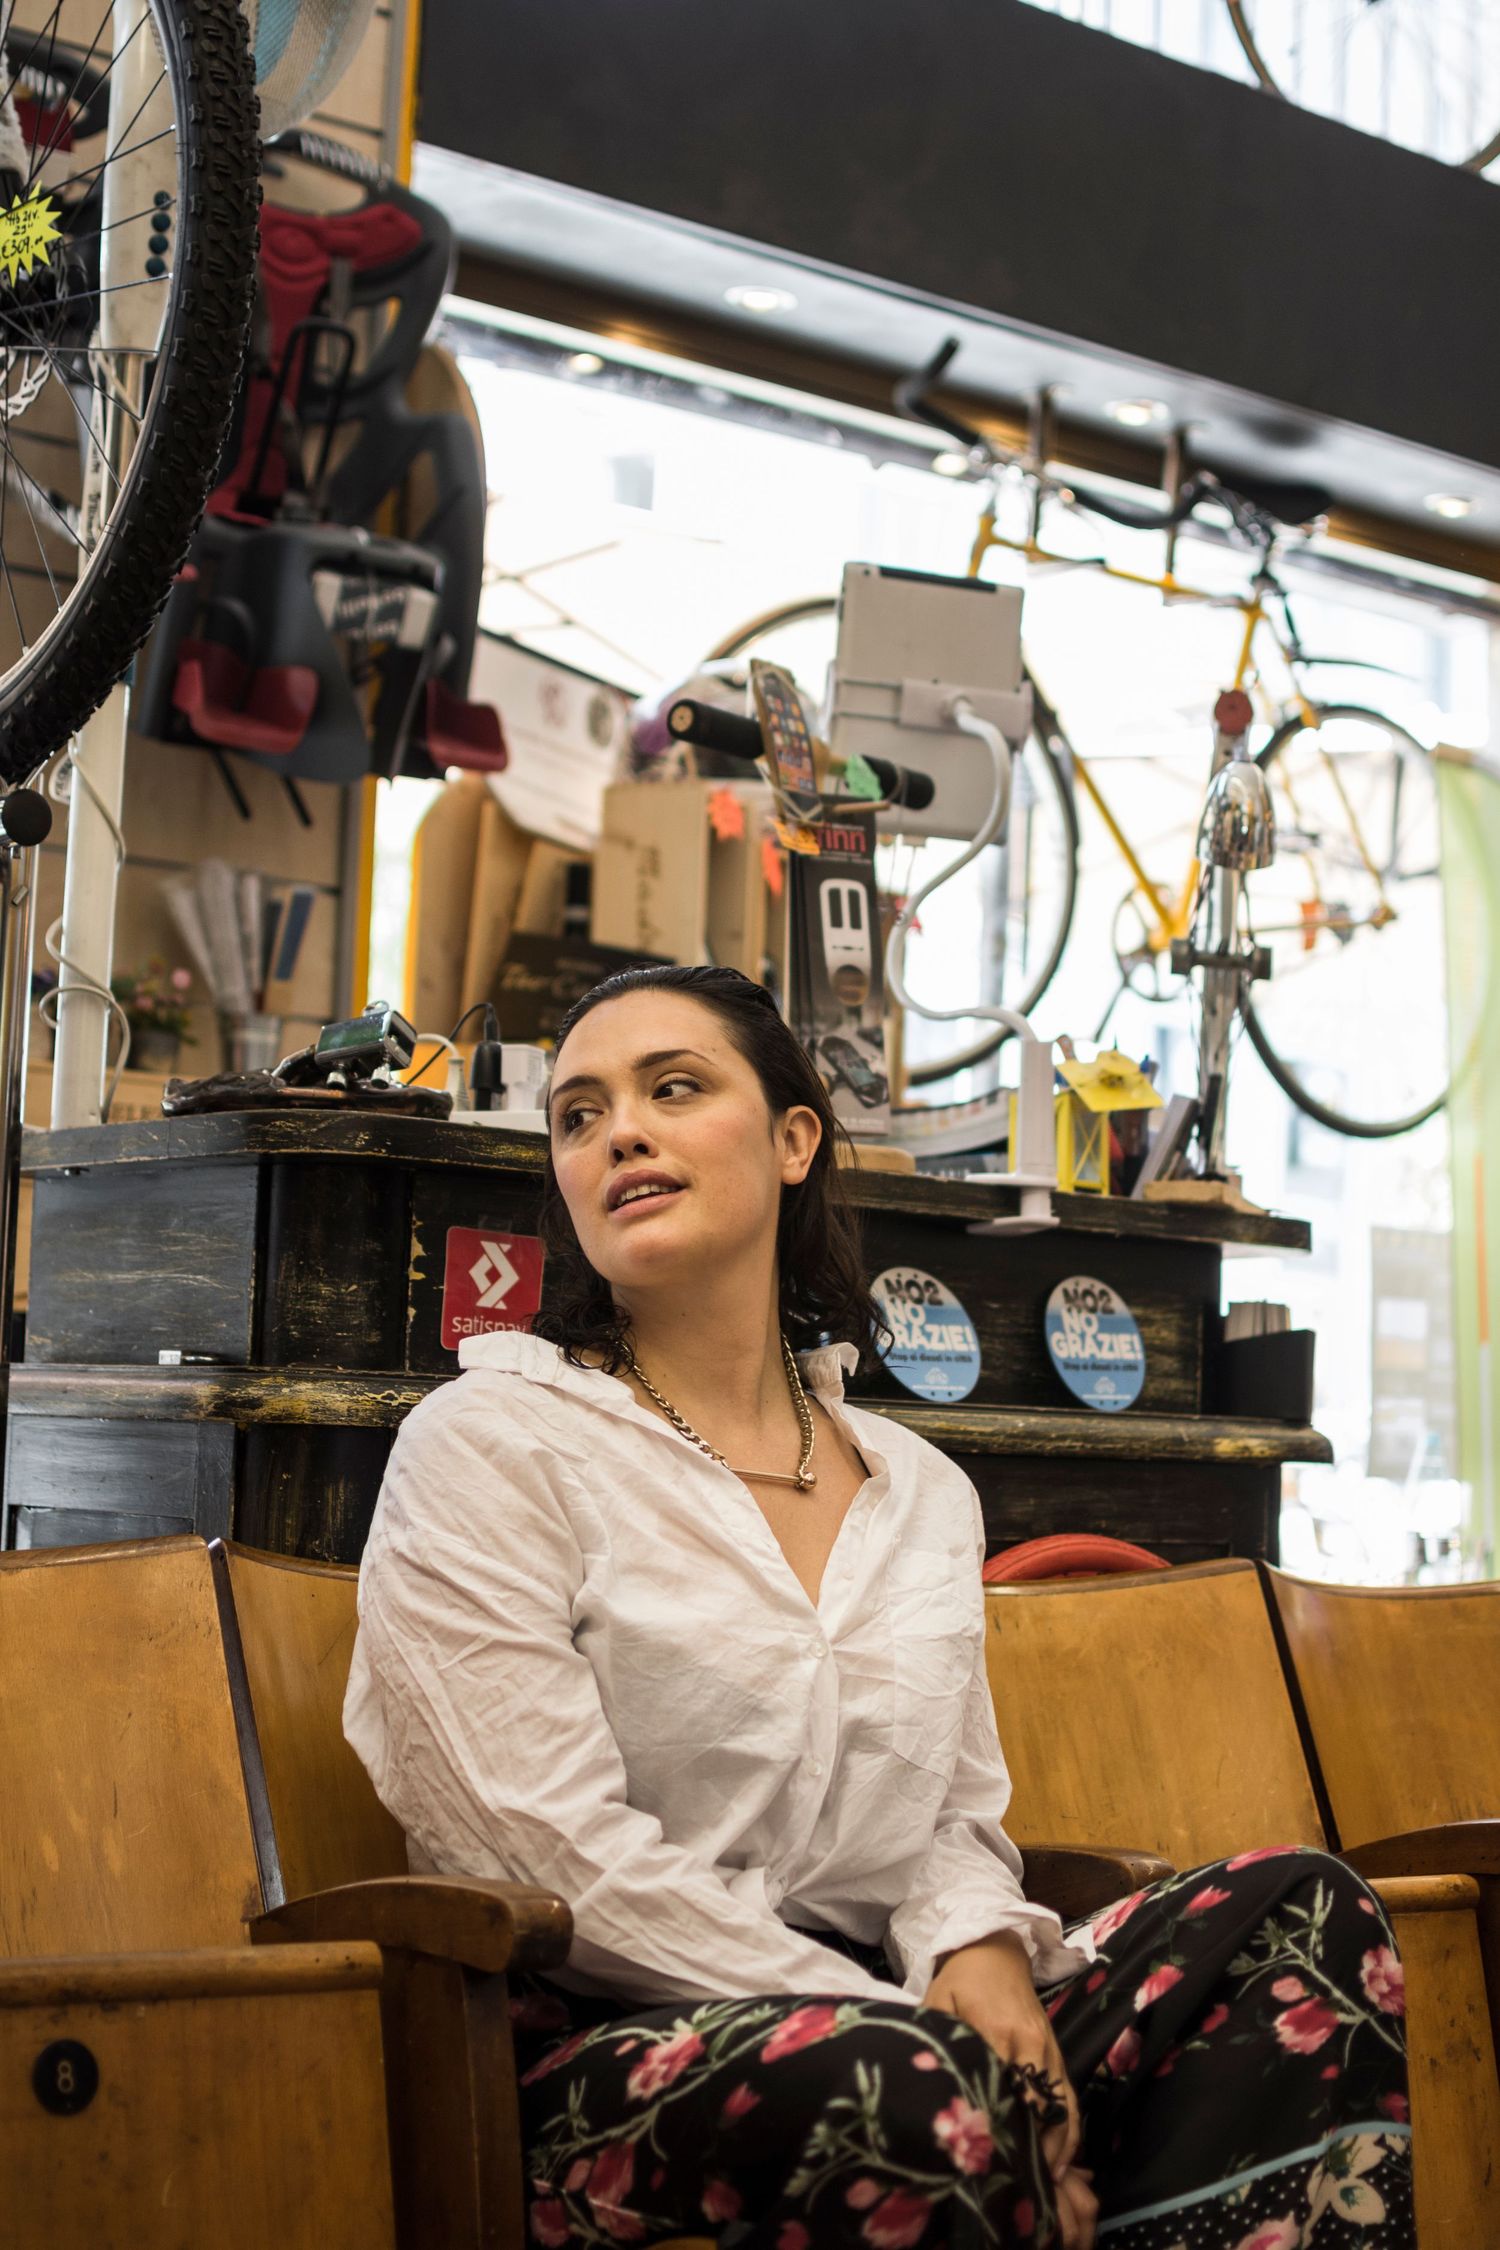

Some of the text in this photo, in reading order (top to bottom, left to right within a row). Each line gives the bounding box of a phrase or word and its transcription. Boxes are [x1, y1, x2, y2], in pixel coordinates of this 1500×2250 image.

[884, 1296, 926, 1327] NO
[1062, 1306, 1099, 1337] NO
[1051, 1331, 1143, 1359] GRAZIE!
[57, 2060, 74, 2094] 8
